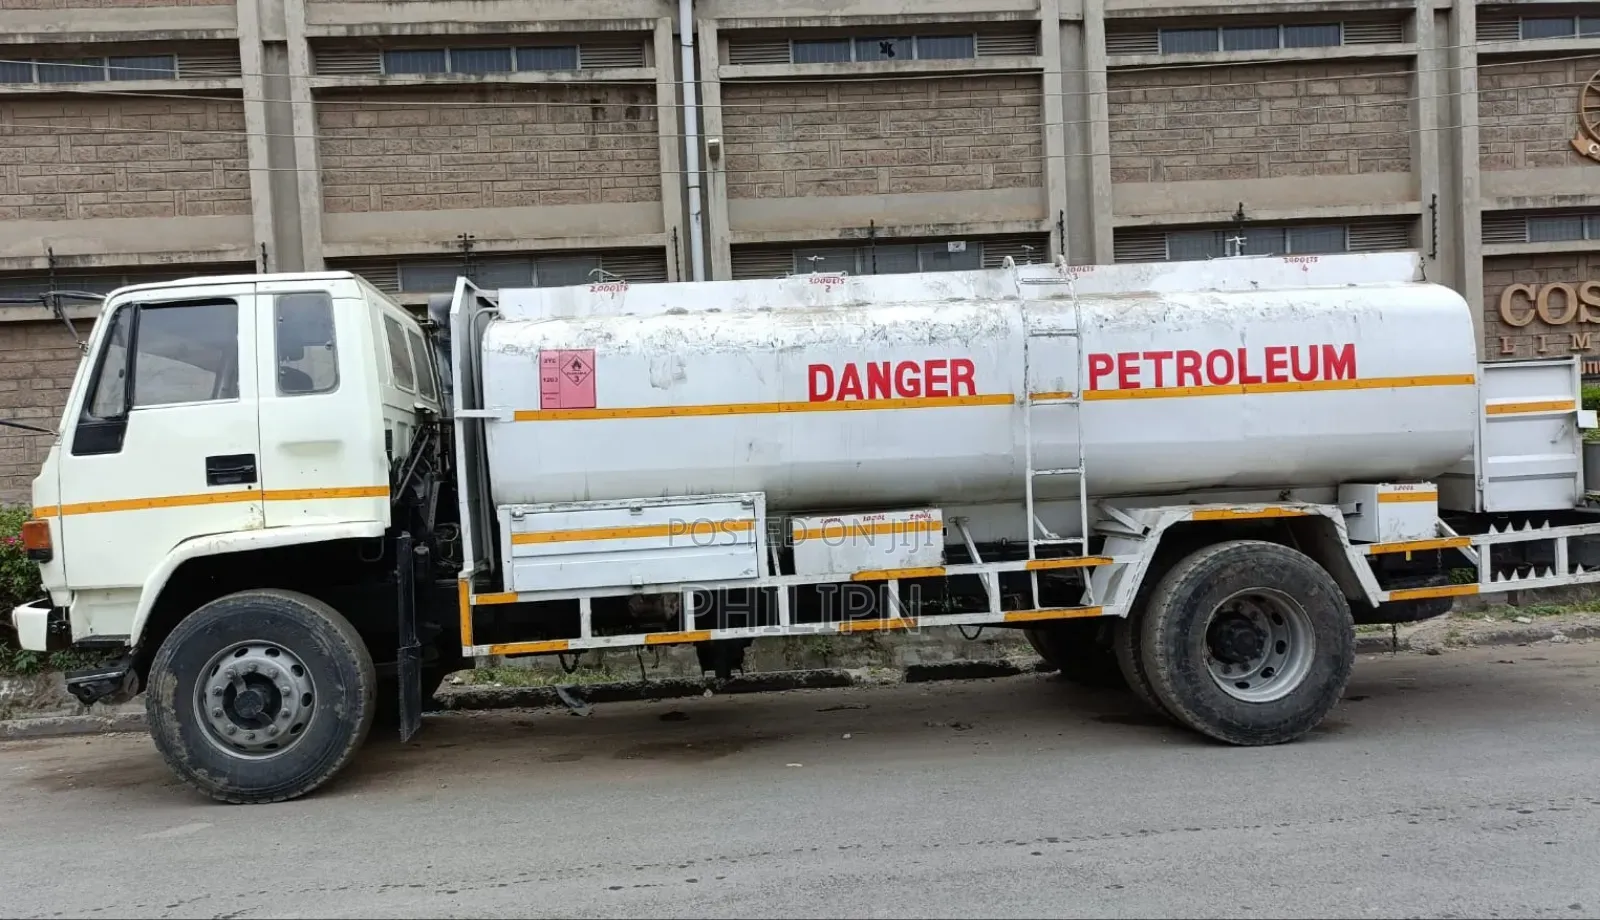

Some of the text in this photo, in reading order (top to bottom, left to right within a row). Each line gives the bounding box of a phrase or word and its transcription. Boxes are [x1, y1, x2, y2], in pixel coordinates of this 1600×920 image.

[1501, 281, 1600, 327] COS
[1500, 332, 1592, 354] LIM
[808, 343, 1357, 403] DANGER PETROLEUM
